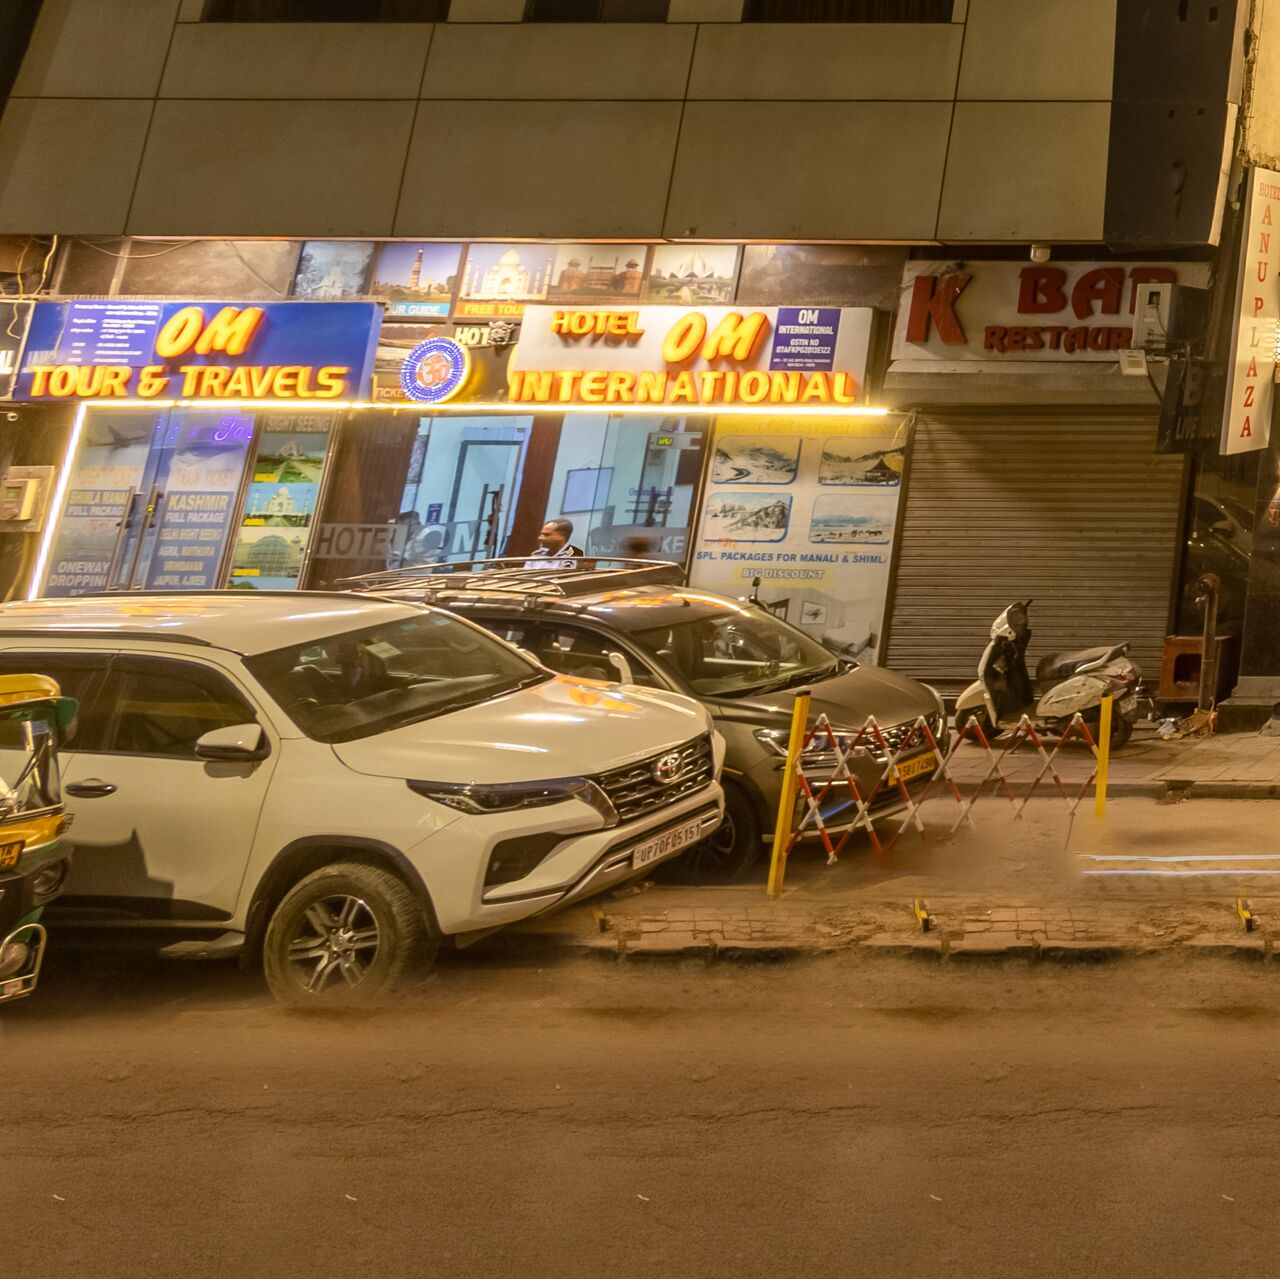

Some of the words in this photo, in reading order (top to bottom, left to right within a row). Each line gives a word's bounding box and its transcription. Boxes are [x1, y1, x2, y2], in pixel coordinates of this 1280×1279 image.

[1259, 181, 1280, 200] HOTEL
[408, 304, 441, 316] GUIDE
[464, 304, 495, 315] FREE
[498, 304, 524, 316] TOU
[798, 309, 819, 324] OM
[906, 275, 973, 344] K
[551, 311, 645, 336] HOTEL
[778, 325, 834, 335] INTERNATIONAL
[155, 306, 266, 358] OM
[455, 327, 490, 345] HOT
[662, 312, 771, 363] OM
[29, 365, 133, 397] TOUR
[136, 365, 170, 397] &
[179, 365, 350, 398] TRAVELS
[508, 370, 857, 404] INTERNATIONAL
[376, 387, 404, 399] TICKE
[168, 495, 229, 511] KASHMIR
[67, 506, 90, 516] FULL
[91, 506, 125, 517] PACKAG
[165, 512, 187, 522] FULL
[187, 512, 226, 523] PACKAGE
[720, 553, 773, 562] PACKAGES
[776, 553, 797, 563] FOR
[800, 554, 839, 563] MANALI
[842, 555, 849, 563] &
[58, 562, 111, 574] ONEWAY
[742, 568, 761, 578] BIG
[765, 568, 824, 579] DISCOUNT
